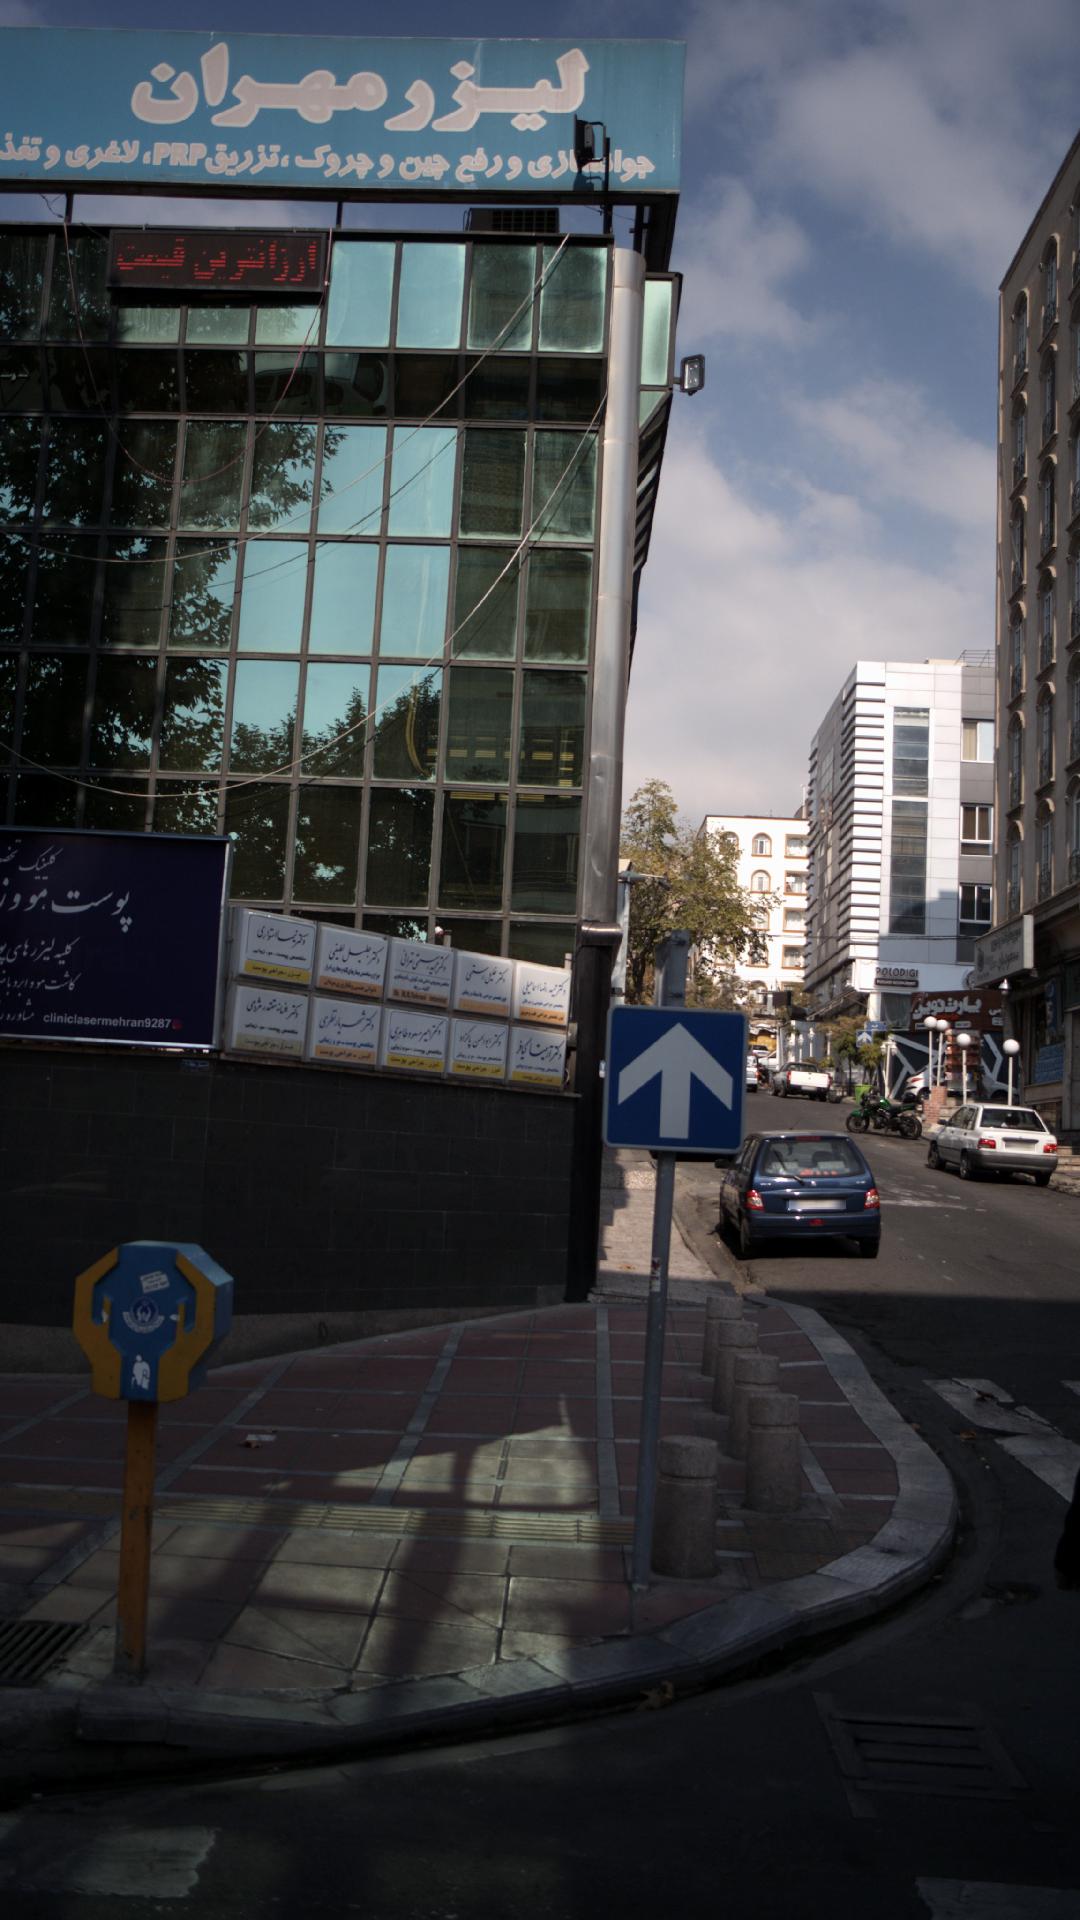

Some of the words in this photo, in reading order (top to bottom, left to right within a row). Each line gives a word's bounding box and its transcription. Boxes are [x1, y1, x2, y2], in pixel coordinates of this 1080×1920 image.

[131, 42, 388, 127] مهران
[384, 47, 590, 132] لیزر
[43, 144, 61, 170] و
[65, 139, 140, 170] لاغری
[294, 144, 375, 179] چروک
[377, 153, 395, 179] و
[398, 152, 451, 181] چین
[455, 146, 504, 183] رفع
[507, 155, 523, 181] و
[116, 237, 185, 279] قیمت
[17, 844, 64, 881] کلینیک
[51, 887, 134, 934] پوست
[43, 1012, 173, 1030] cliniclasermehran9287
